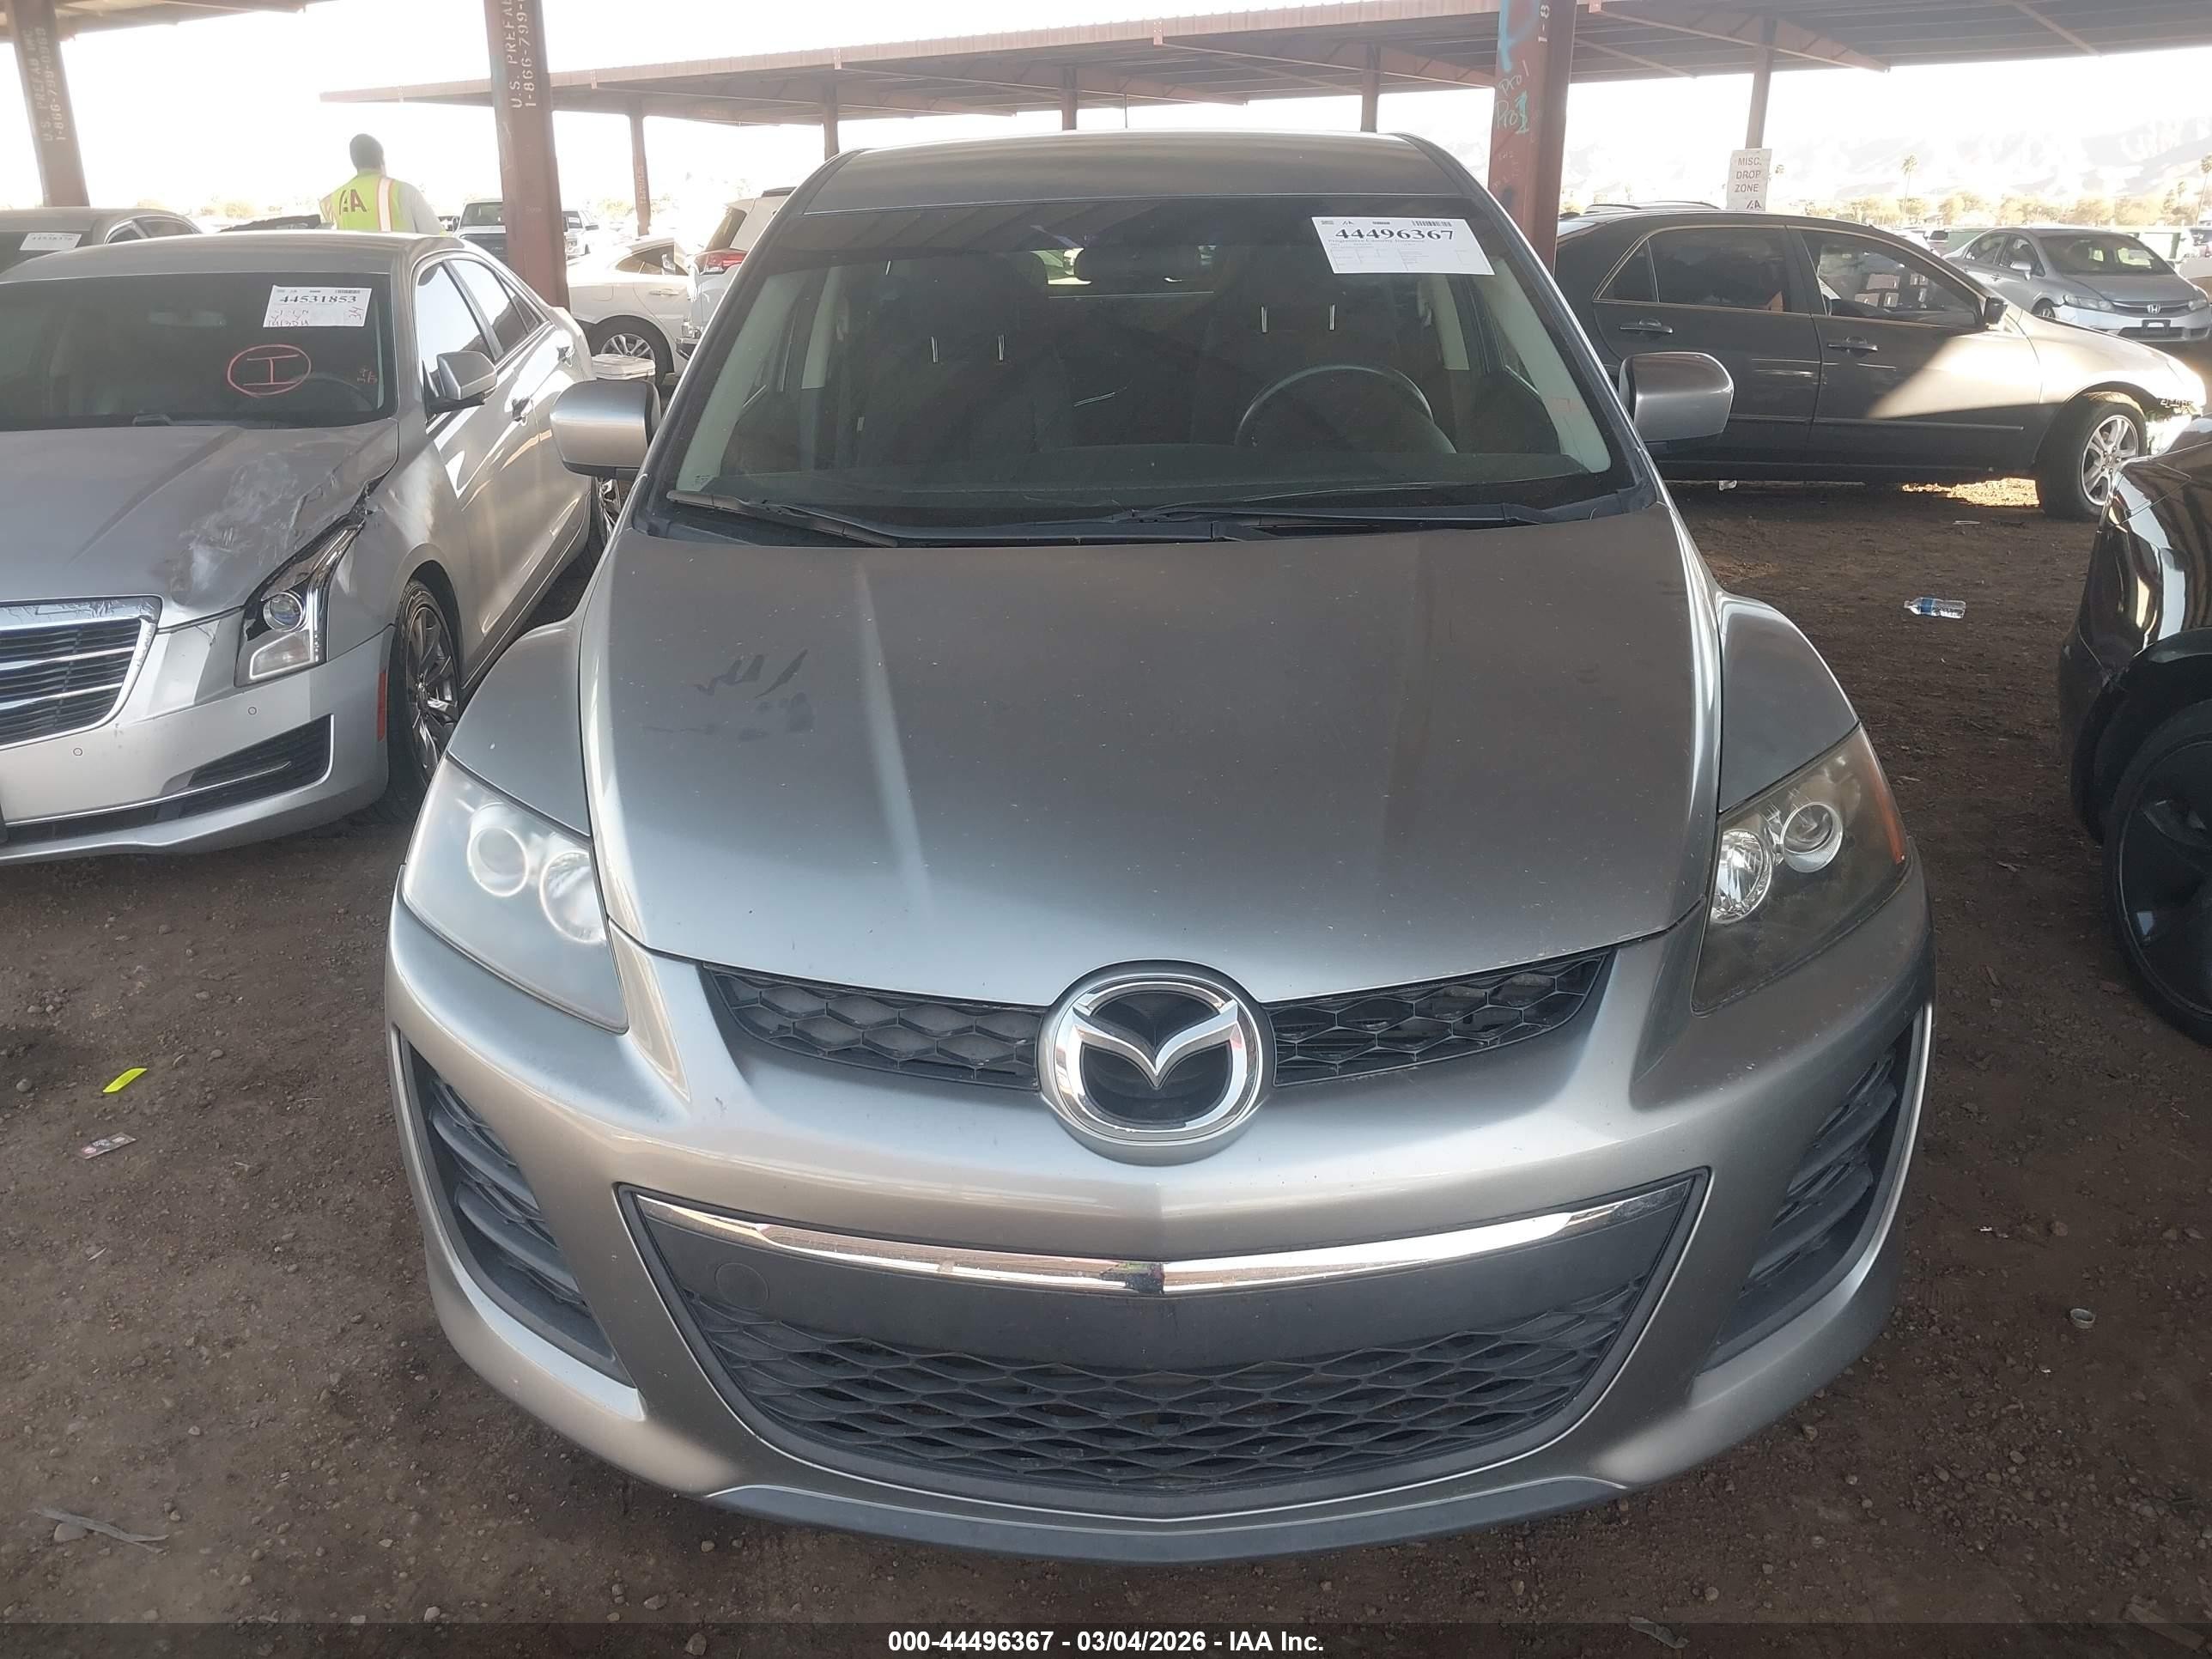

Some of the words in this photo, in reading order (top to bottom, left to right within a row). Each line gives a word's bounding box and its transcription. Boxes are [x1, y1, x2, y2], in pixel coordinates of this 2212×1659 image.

[515, 0, 537, 106] 1-866-799-
[508, 75, 523, 108] U.S.
[1737, 157, 1762, 166] MISC.
[1735, 170, 1762, 179] DROP
[1734, 183, 1759, 193] ZONE
[1334, 228, 1454, 240] 44496367
